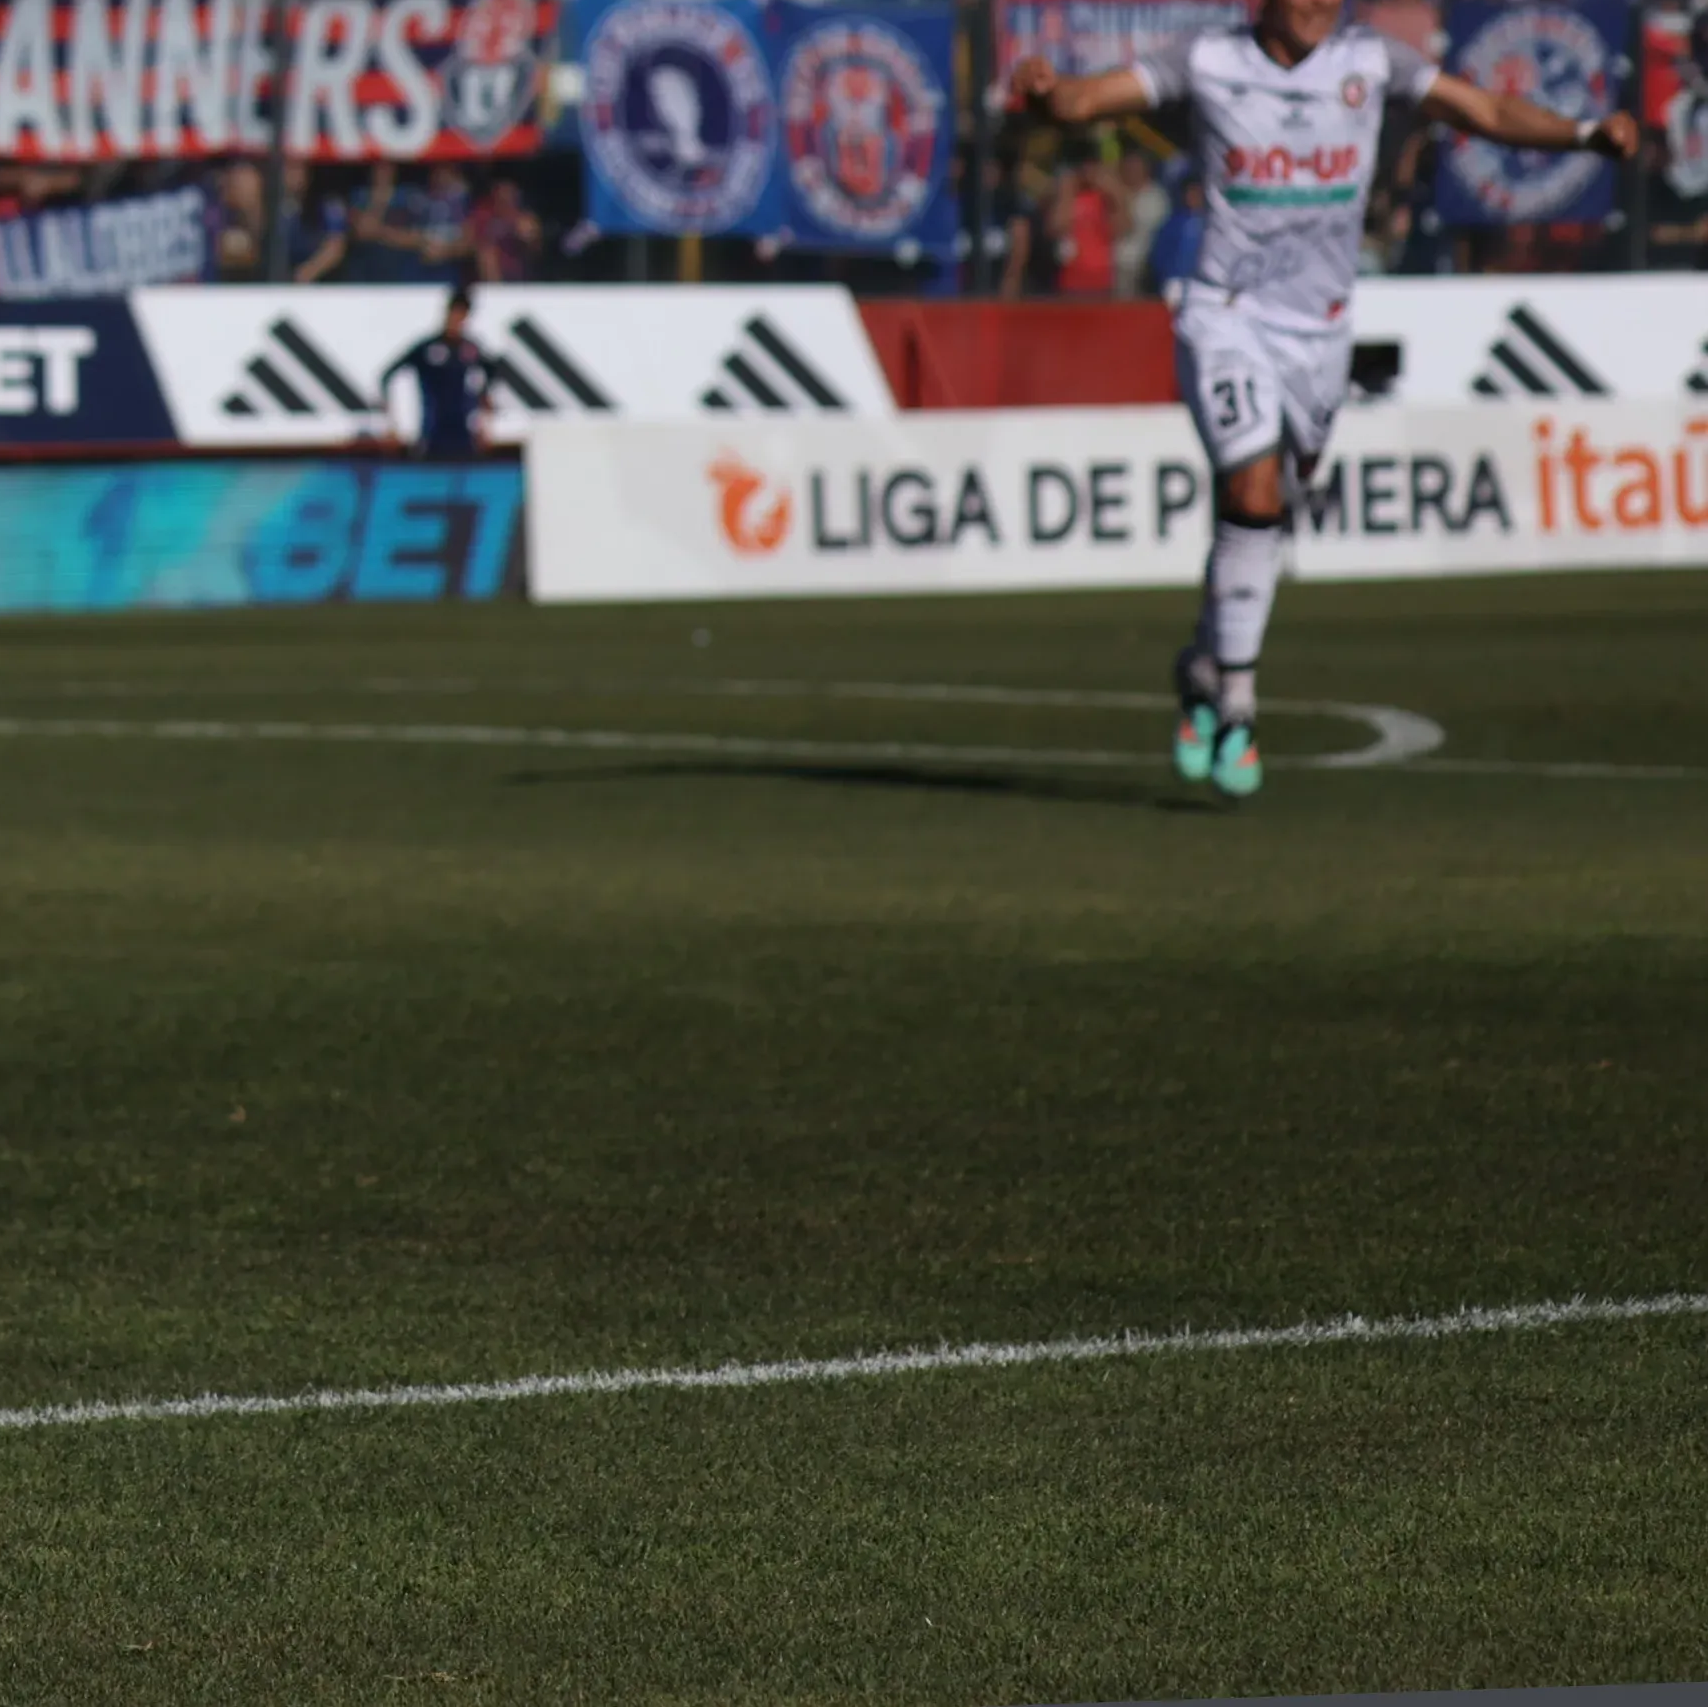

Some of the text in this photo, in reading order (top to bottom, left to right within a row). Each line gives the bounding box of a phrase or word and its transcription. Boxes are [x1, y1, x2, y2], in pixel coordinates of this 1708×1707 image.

[809, 468, 1001, 549] LIGA
[1026, 462, 1132, 546] DE
[1156, 452, 1513, 542] PMERA
